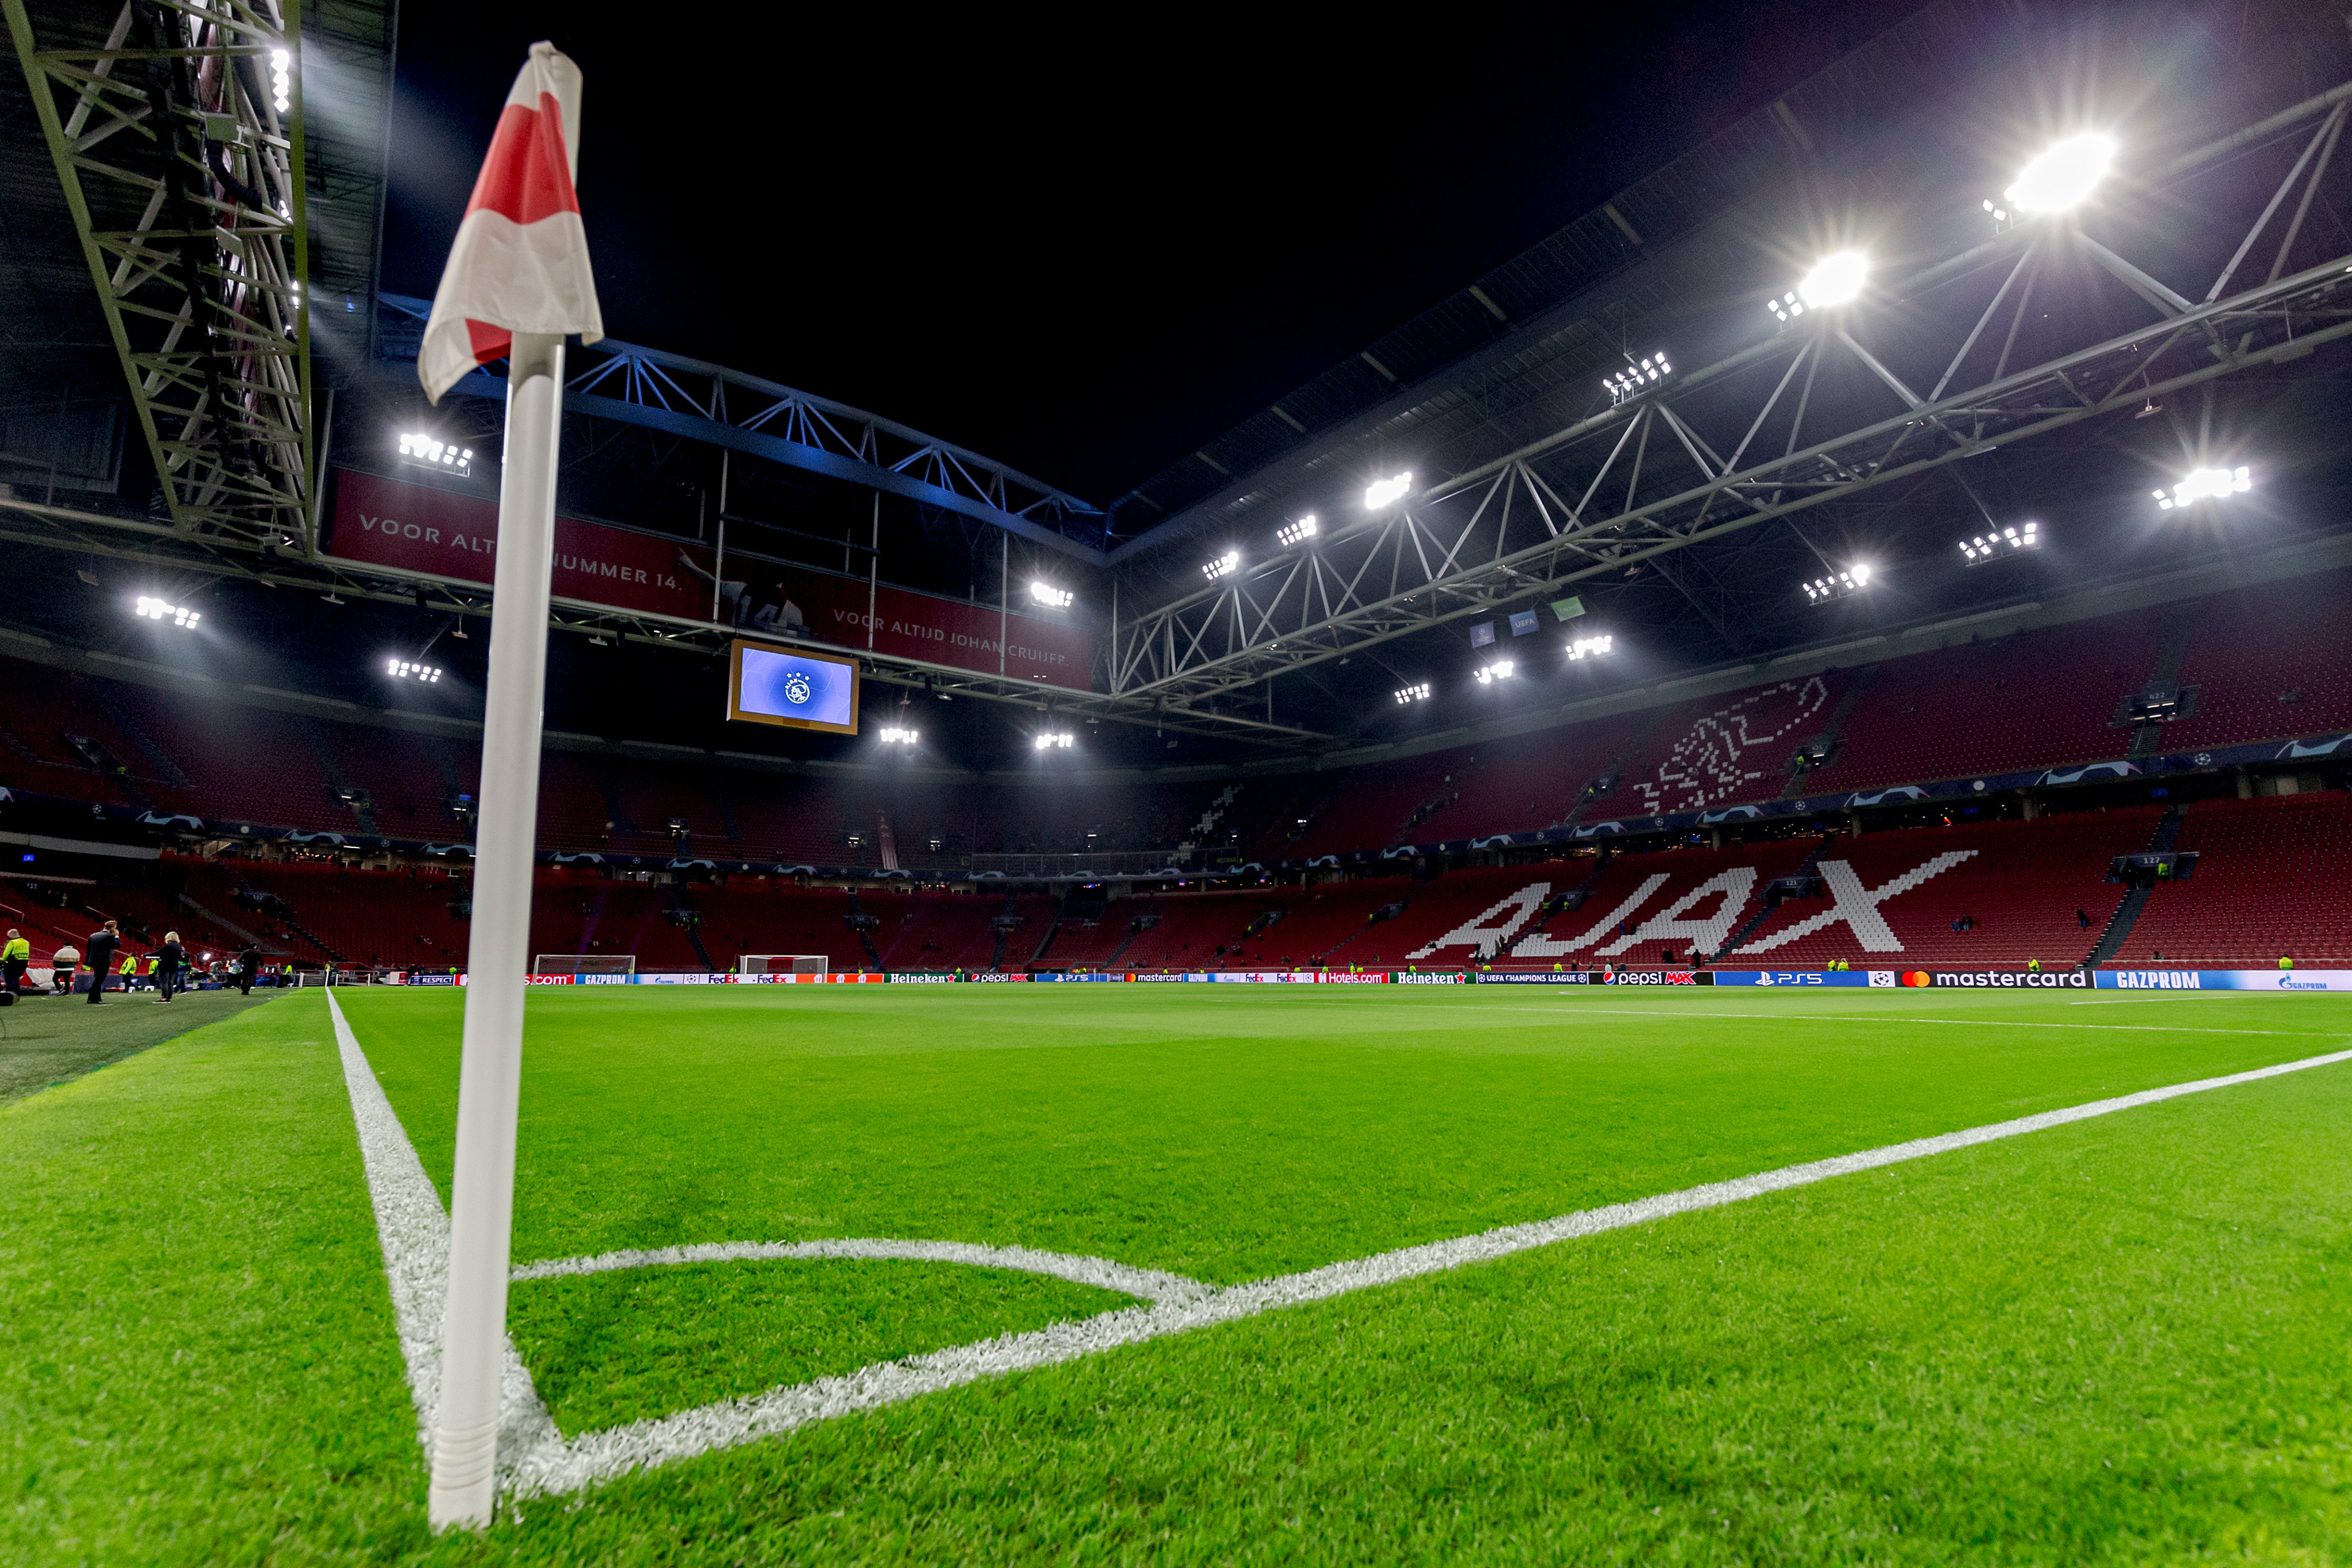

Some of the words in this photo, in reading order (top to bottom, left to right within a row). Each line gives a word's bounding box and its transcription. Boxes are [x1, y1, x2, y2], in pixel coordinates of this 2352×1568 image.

[359, 514, 440, 544] VOOR
[657, 574, 682, 591] 14.
[1515, 618, 1535, 628] UEFA
[834, 609, 884, 630] VOOR
[891, 621, 944, 641] ALTIJD
[950, 633, 1001, 653] JOHAN
[1405, 850, 1979, 959] AJAX
[585, 975, 626, 985] GAZPROM
[709, 974, 738, 984] FedEx
[757, 974, 787, 984] FedEx
[891, 974, 946, 983] Heineken
[981, 974, 1008, 983] pepsi
[1009, 974, 1028, 982] MAX
[1138, 974, 1182, 982] mastercard
[1245, 973, 1264, 982] FedEx
[1277, 973, 1296, 982] FedEx
[1329, 973, 1382, 984] Hotels.com
[1398, 972, 1454, 984] Heineken
[1618, 971, 1662, 985] pepsi
[1665, 971, 1697, 985] MAX
[1778, 973, 1823, 984] PS5
[1936, 970, 2086, 987] mastercard
[2117, 971, 2200, 989] GAZPROM
